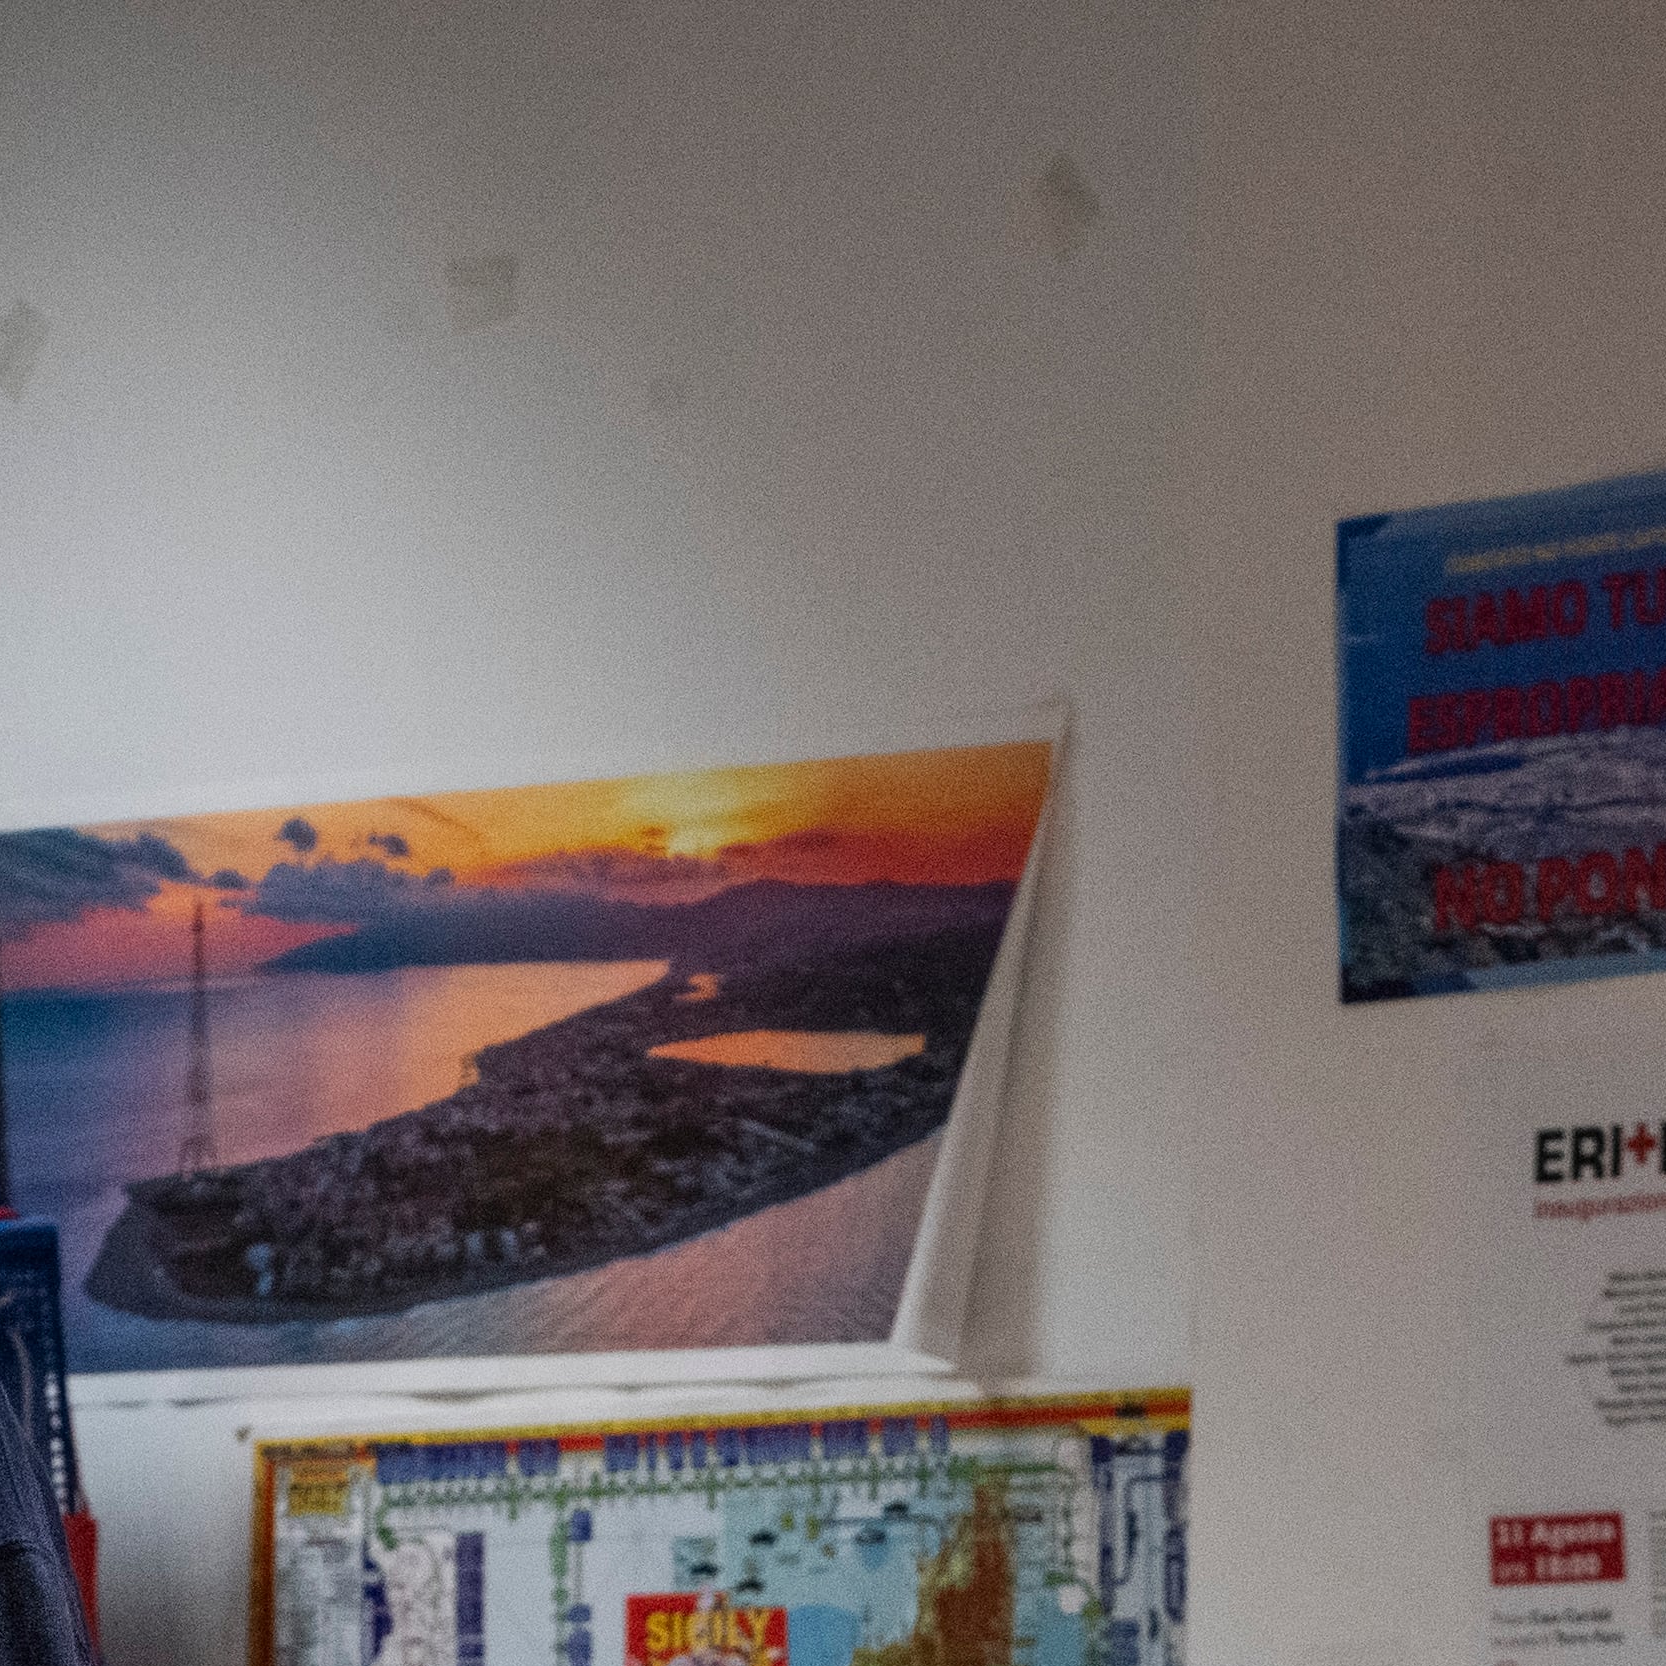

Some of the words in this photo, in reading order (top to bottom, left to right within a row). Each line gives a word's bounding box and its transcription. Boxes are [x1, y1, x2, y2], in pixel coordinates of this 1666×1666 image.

[1424, 579, 1588, 655] SIAMO
[1433, 860, 1527, 931] NO
[1529, 1519, 1615, 1552] Agosto
[645, 1608, 769, 1655] SICILY
